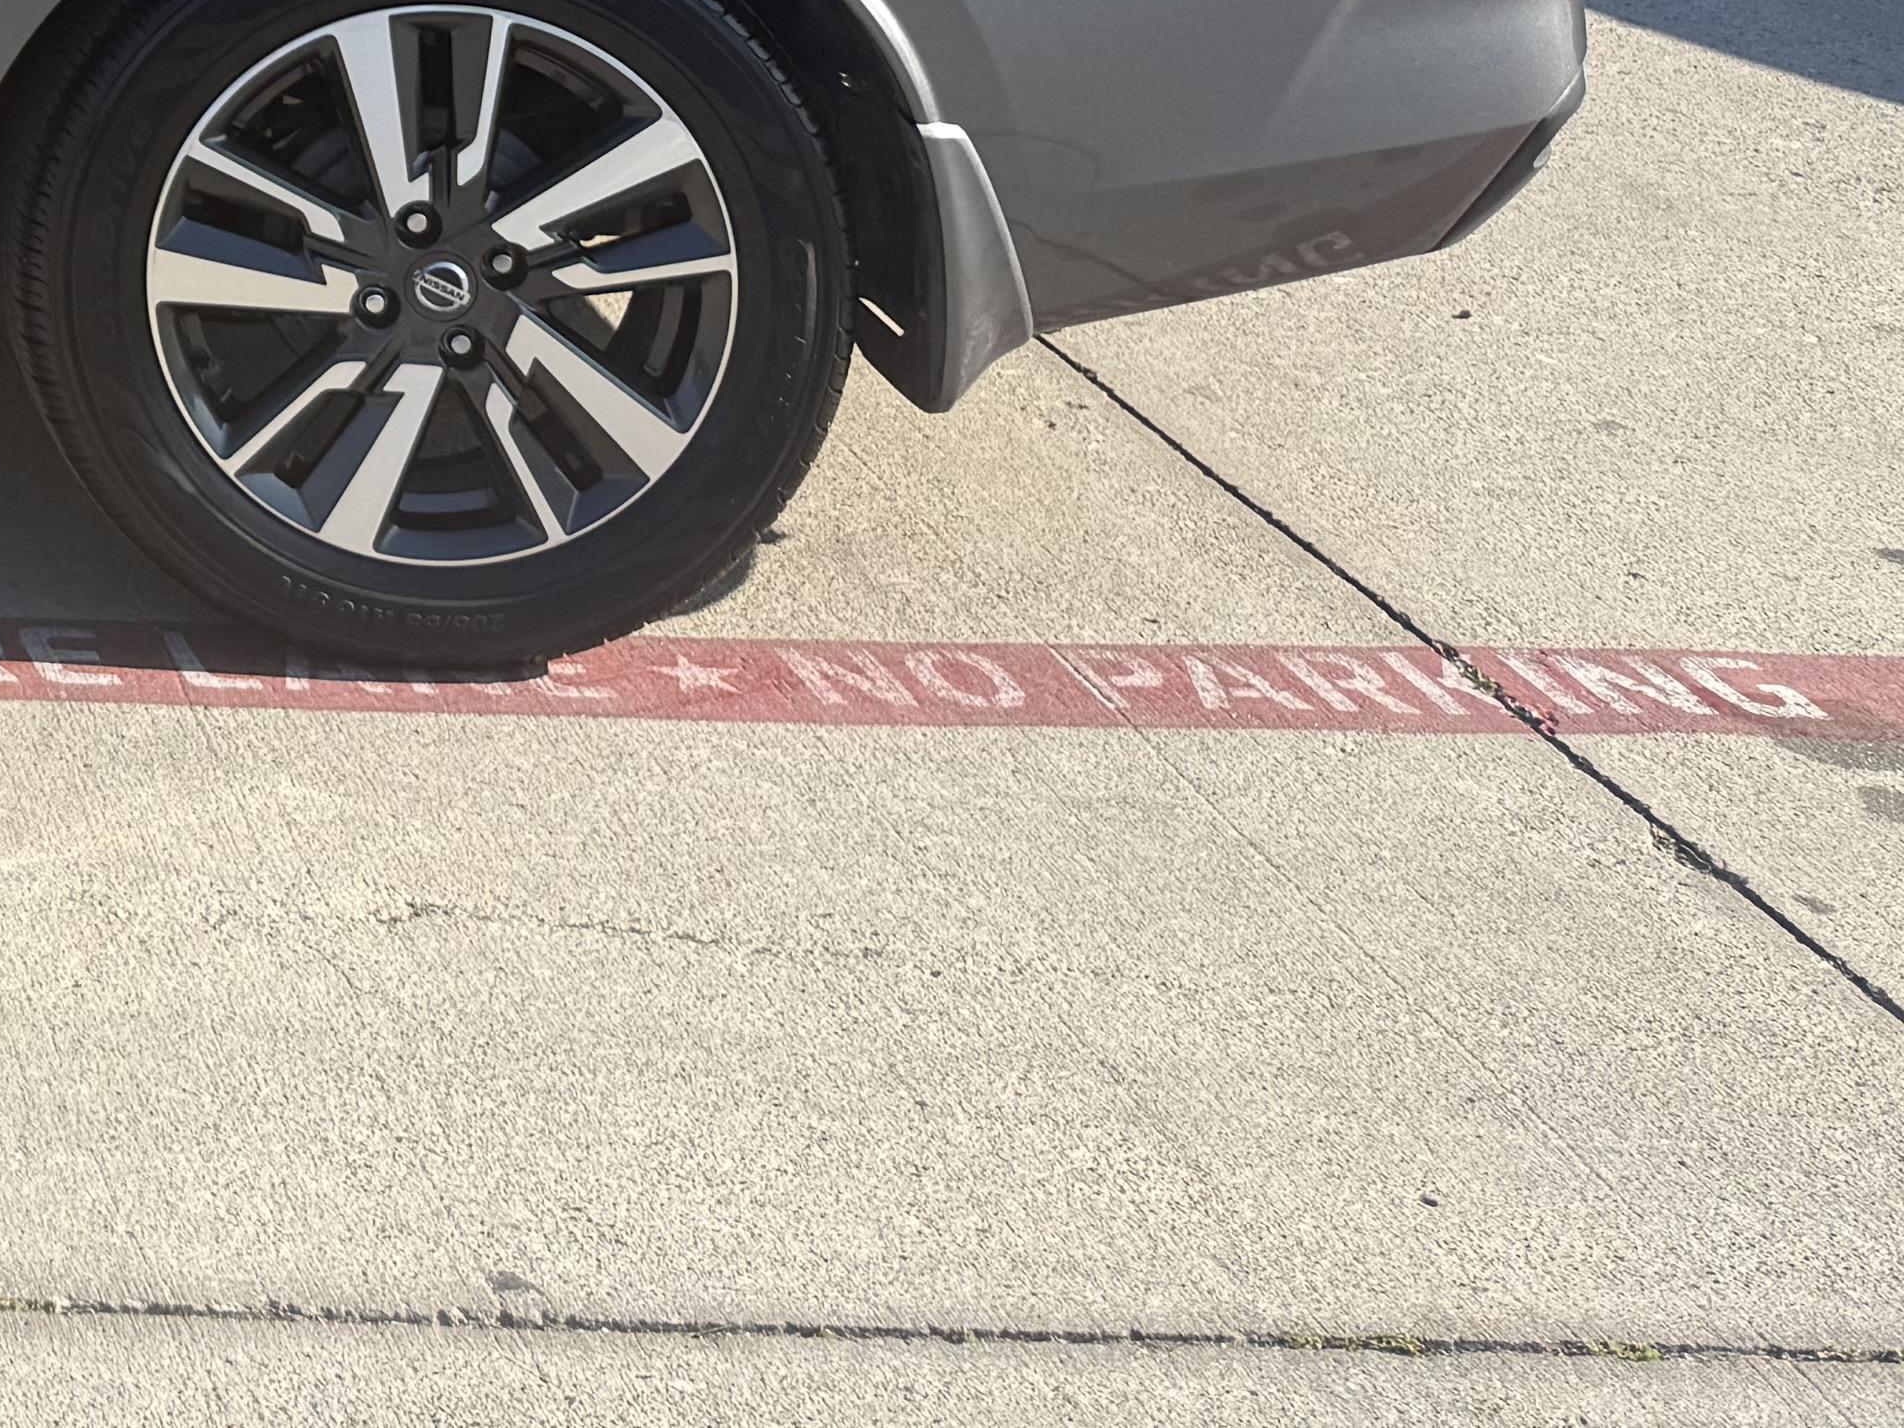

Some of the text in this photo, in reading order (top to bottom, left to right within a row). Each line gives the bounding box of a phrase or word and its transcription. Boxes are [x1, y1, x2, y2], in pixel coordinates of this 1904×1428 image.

[423, 277, 465, 301] NISSAN
[788, 643, 1027, 711] NO
[1064, 649, 1832, 721] PARKING
